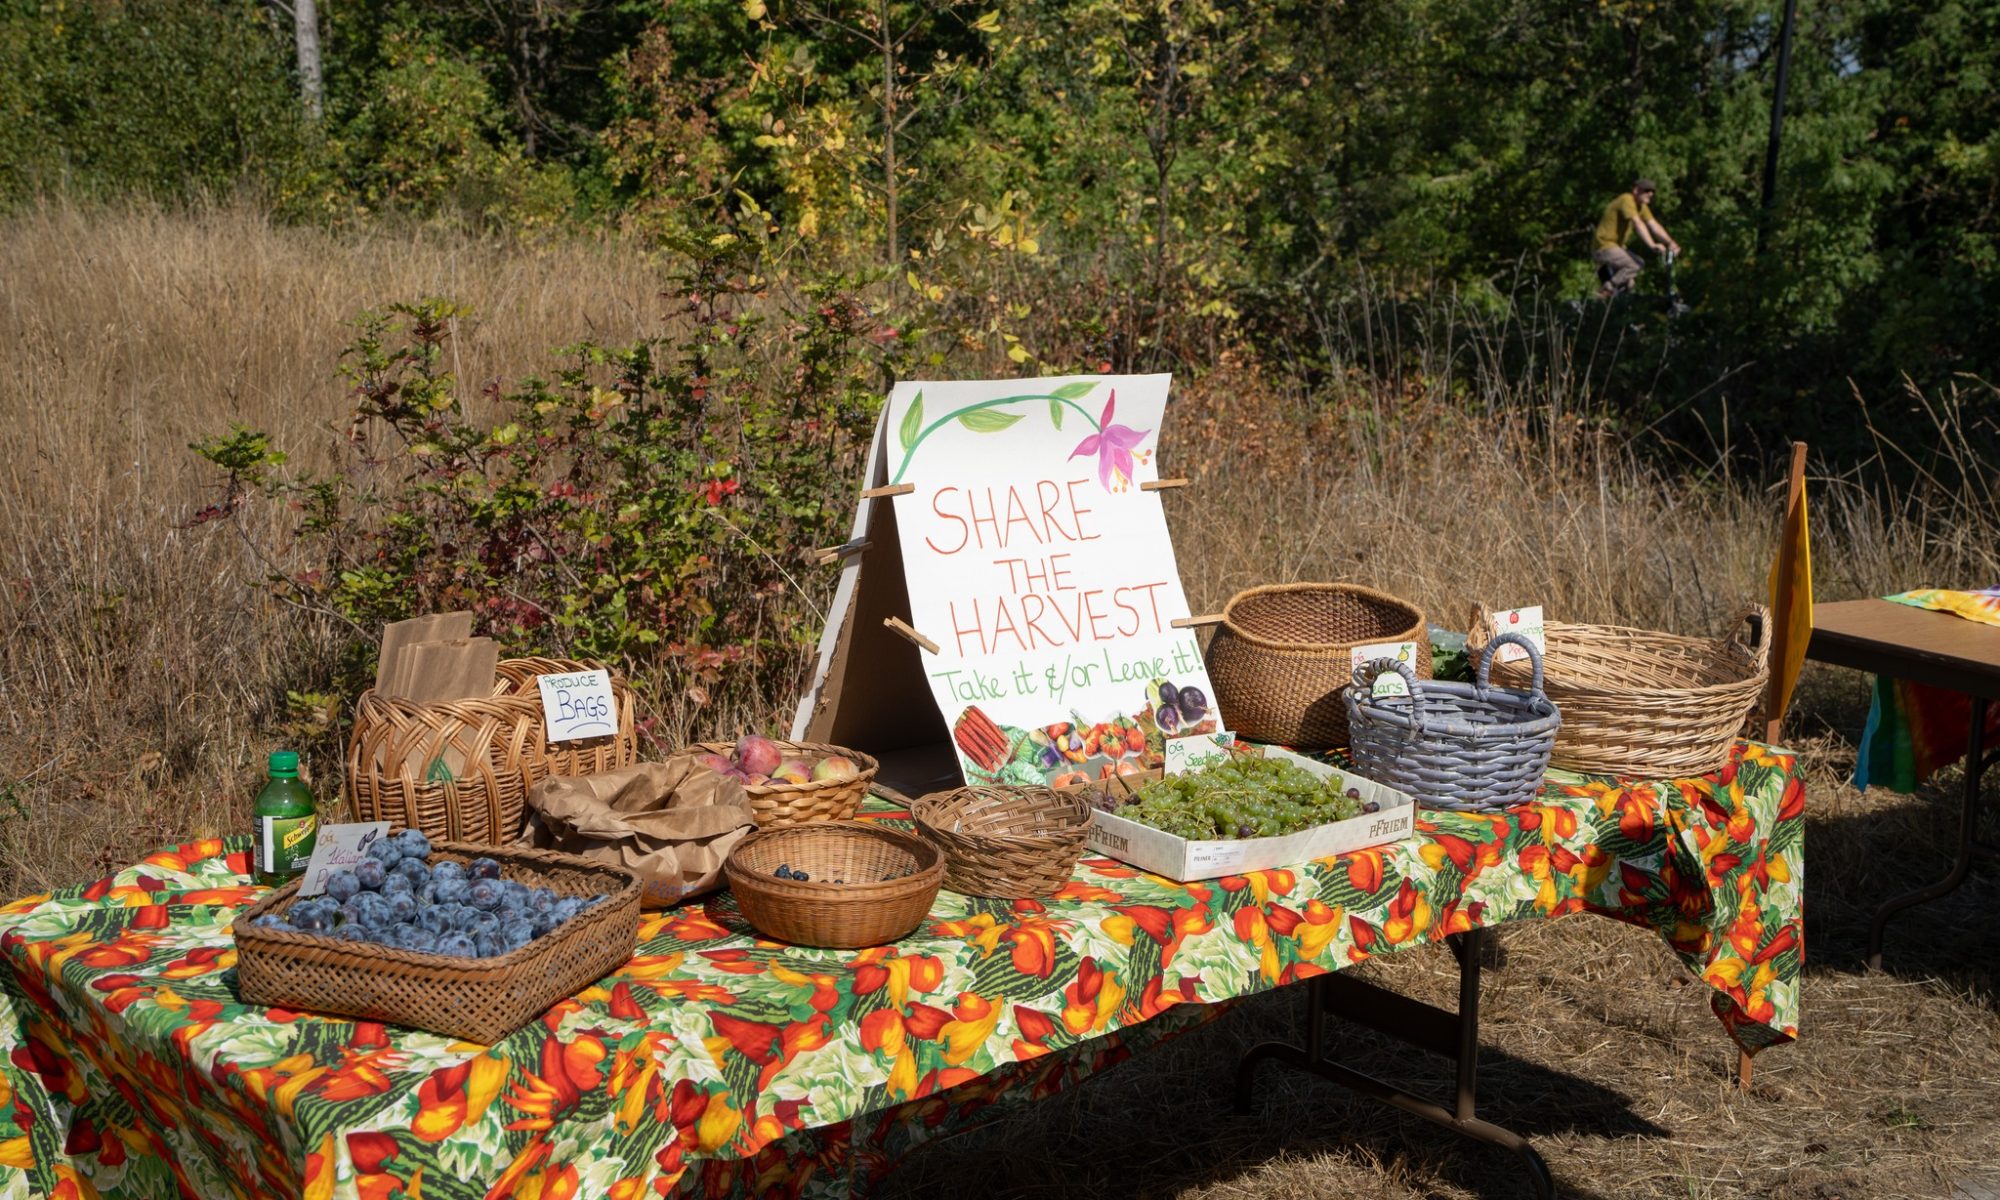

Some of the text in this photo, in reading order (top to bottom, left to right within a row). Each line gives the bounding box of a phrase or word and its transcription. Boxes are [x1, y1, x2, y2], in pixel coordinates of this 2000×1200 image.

[925, 478, 1101, 555] SHARE
[993, 553, 1077, 594] THE
[950, 581, 1168, 658] HARVEST
[542, 674, 599, 690] PRODUCE
[931, 668, 1007, 703] Take
[1012, 660, 1038, 695] it
[1103, 647, 1171, 684] Leave
[1171, 639, 1204, 674] it!
[1372, 683, 1404, 695] ears
[554, 689, 608, 722] BAGS
[1168, 741, 1184, 755] OG
